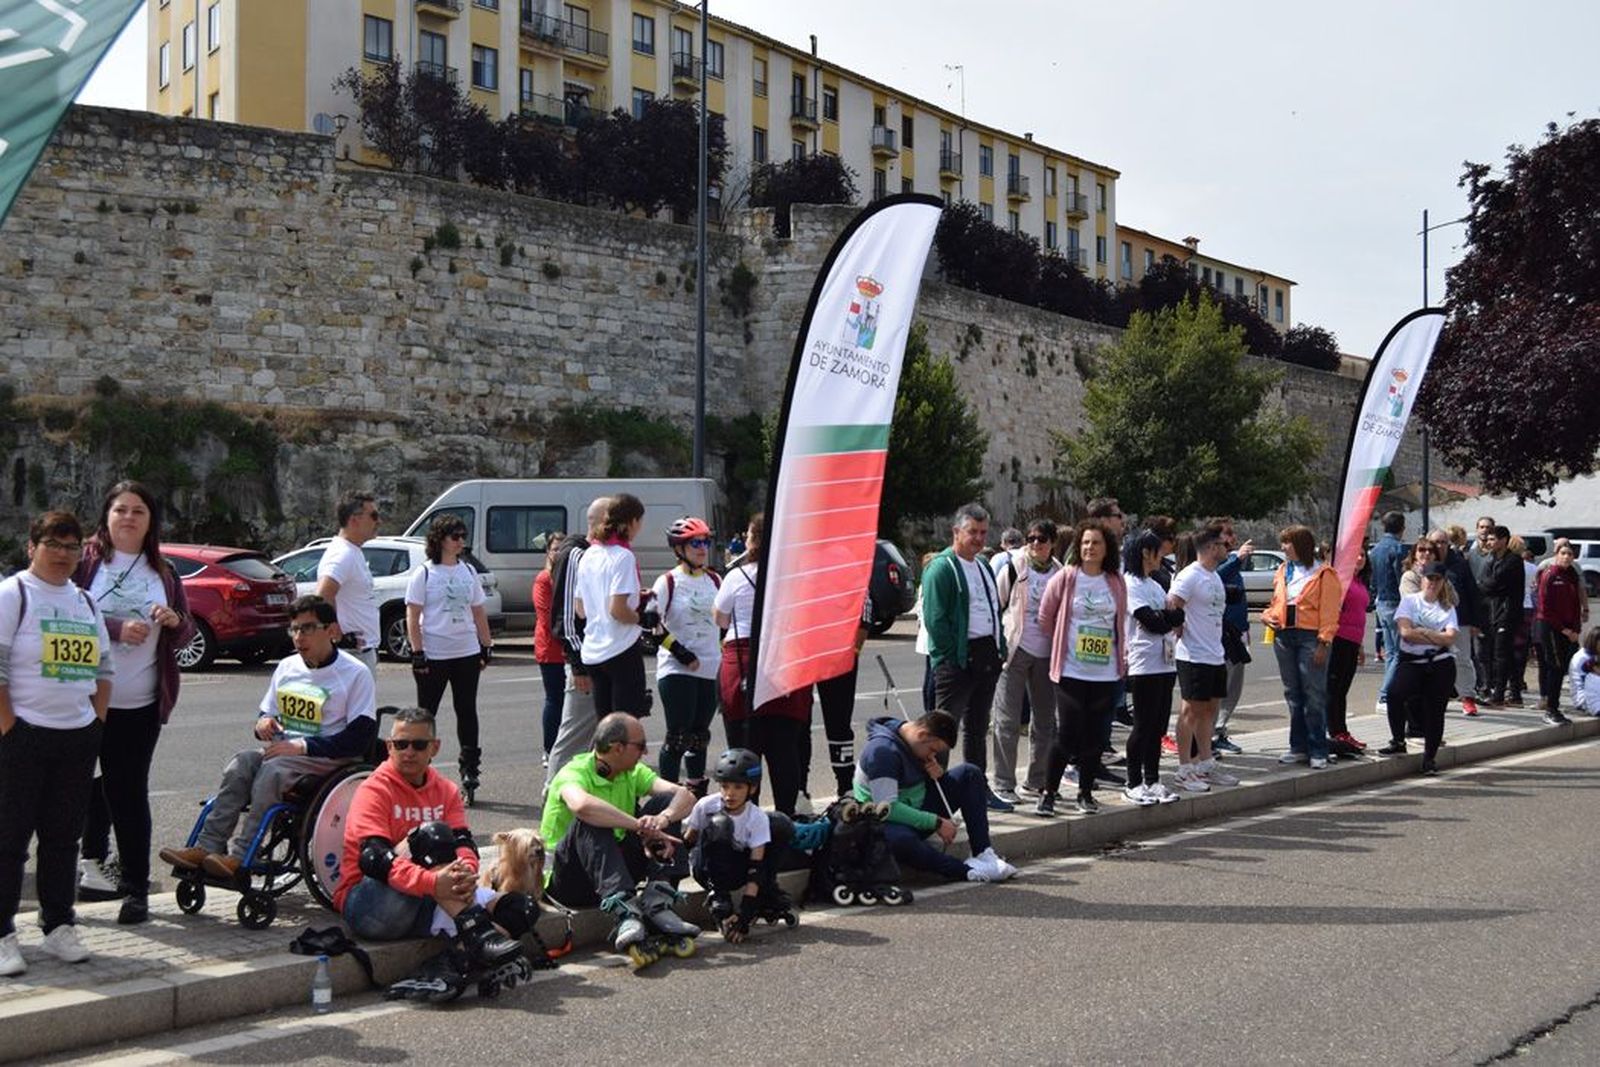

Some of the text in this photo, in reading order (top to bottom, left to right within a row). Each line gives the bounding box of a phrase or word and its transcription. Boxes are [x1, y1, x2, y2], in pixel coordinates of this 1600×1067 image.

[813, 340, 891, 375] AYUNTAMIENTO
[809, 352, 887, 390] DE ZAMORA
[50, 638, 93, 664] 1332
[1081, 637, 1109, 655] 1368
[281, 695, 316, 720] 1328
